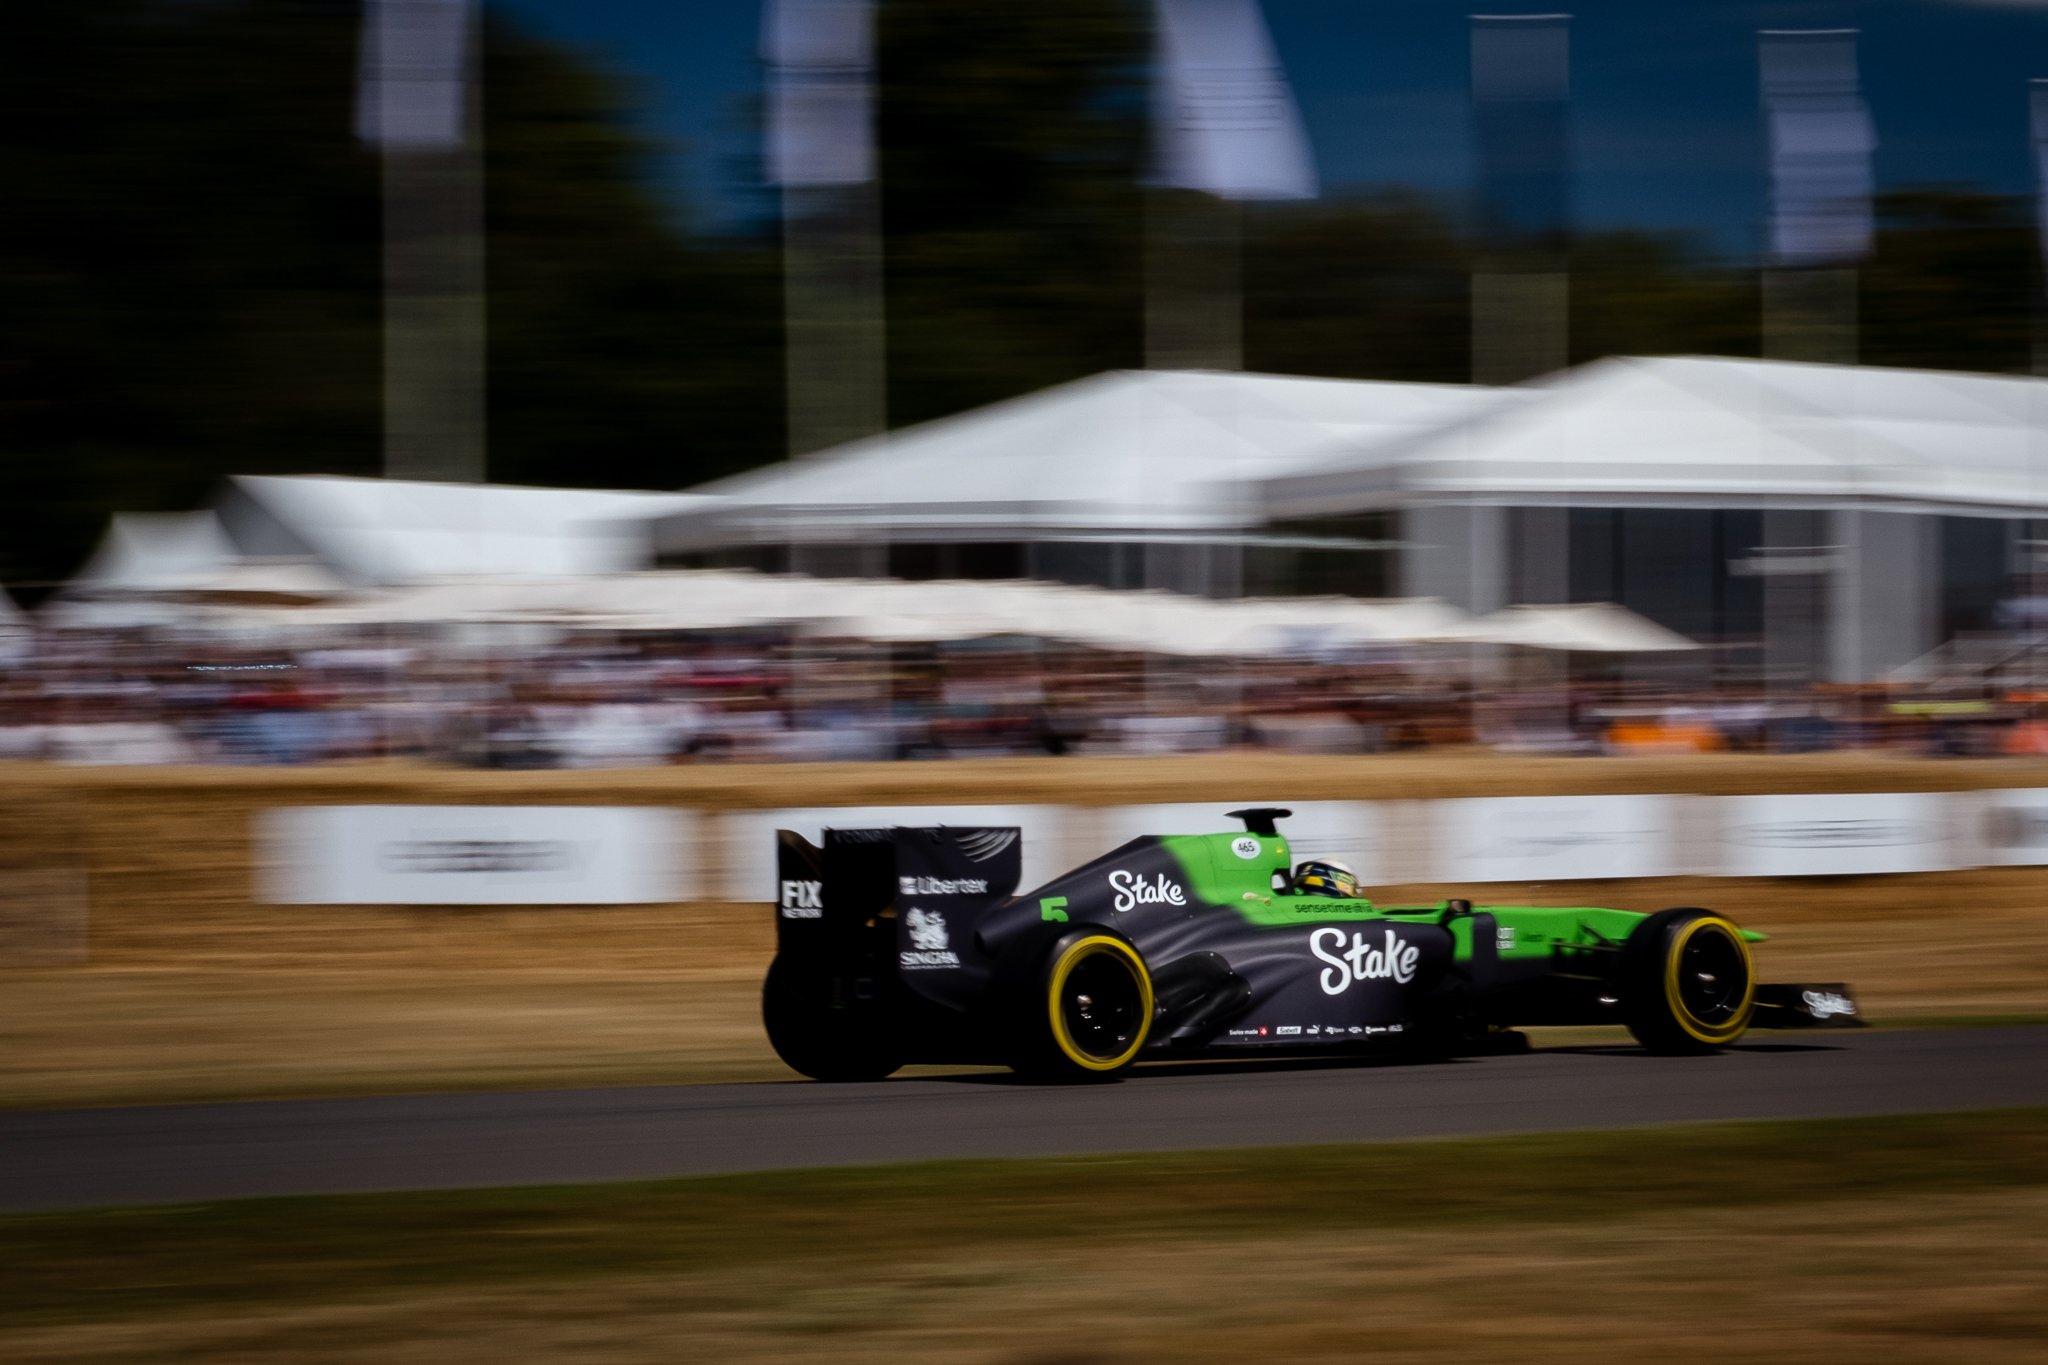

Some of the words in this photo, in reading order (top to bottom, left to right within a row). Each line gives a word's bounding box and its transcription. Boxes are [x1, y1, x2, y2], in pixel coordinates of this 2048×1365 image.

[1237, 841, 1255, 853] 465
[781, 879, 824, 908] FIX
[917, 876, 989, 894] Libertex
[1109, 870, 1187, 912] Stake
[1039, 896, 1071, 923] 5
[1295, 903, 1353, 914] sensetime
[1309, 927, 1420, 996] Stake
